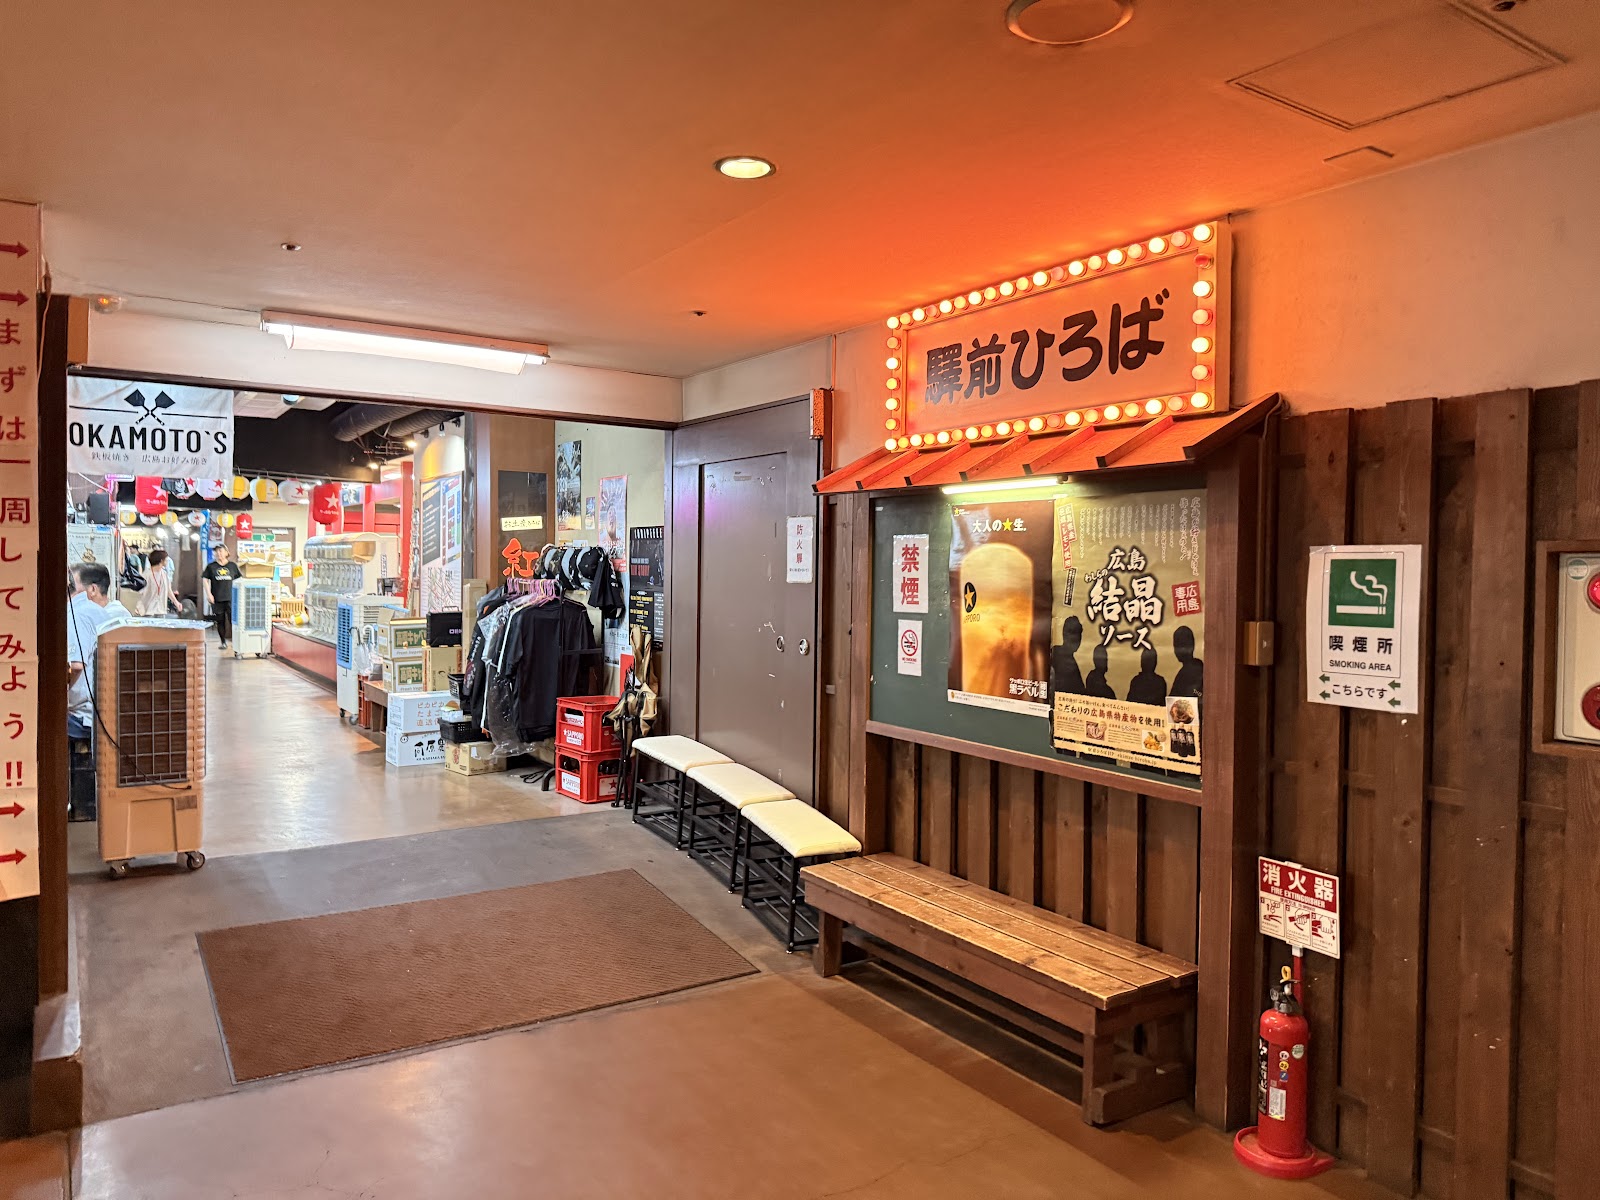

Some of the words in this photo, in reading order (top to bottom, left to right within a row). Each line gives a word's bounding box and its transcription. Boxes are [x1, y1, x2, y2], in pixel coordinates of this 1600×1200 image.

[502, 537, 540, 578] 紅
[1107, 548, 1147, 571] 広島
[901, 543, 920, 606] 禁煙
[1087, 576, 1163, 625] 結晶
[1100, 624, 1152, 650] ソース
[1328, 635, 1393, 655] 喫煙所
[1329, 659, 1367, 670] SMOKING
[1368, 664, 1392, 672] AREA
[1332, 684, 1388, 699] こちらです
[1262, 862, 1334, 902] 消火器
[1271, 886, 1284, 896] FIRE
